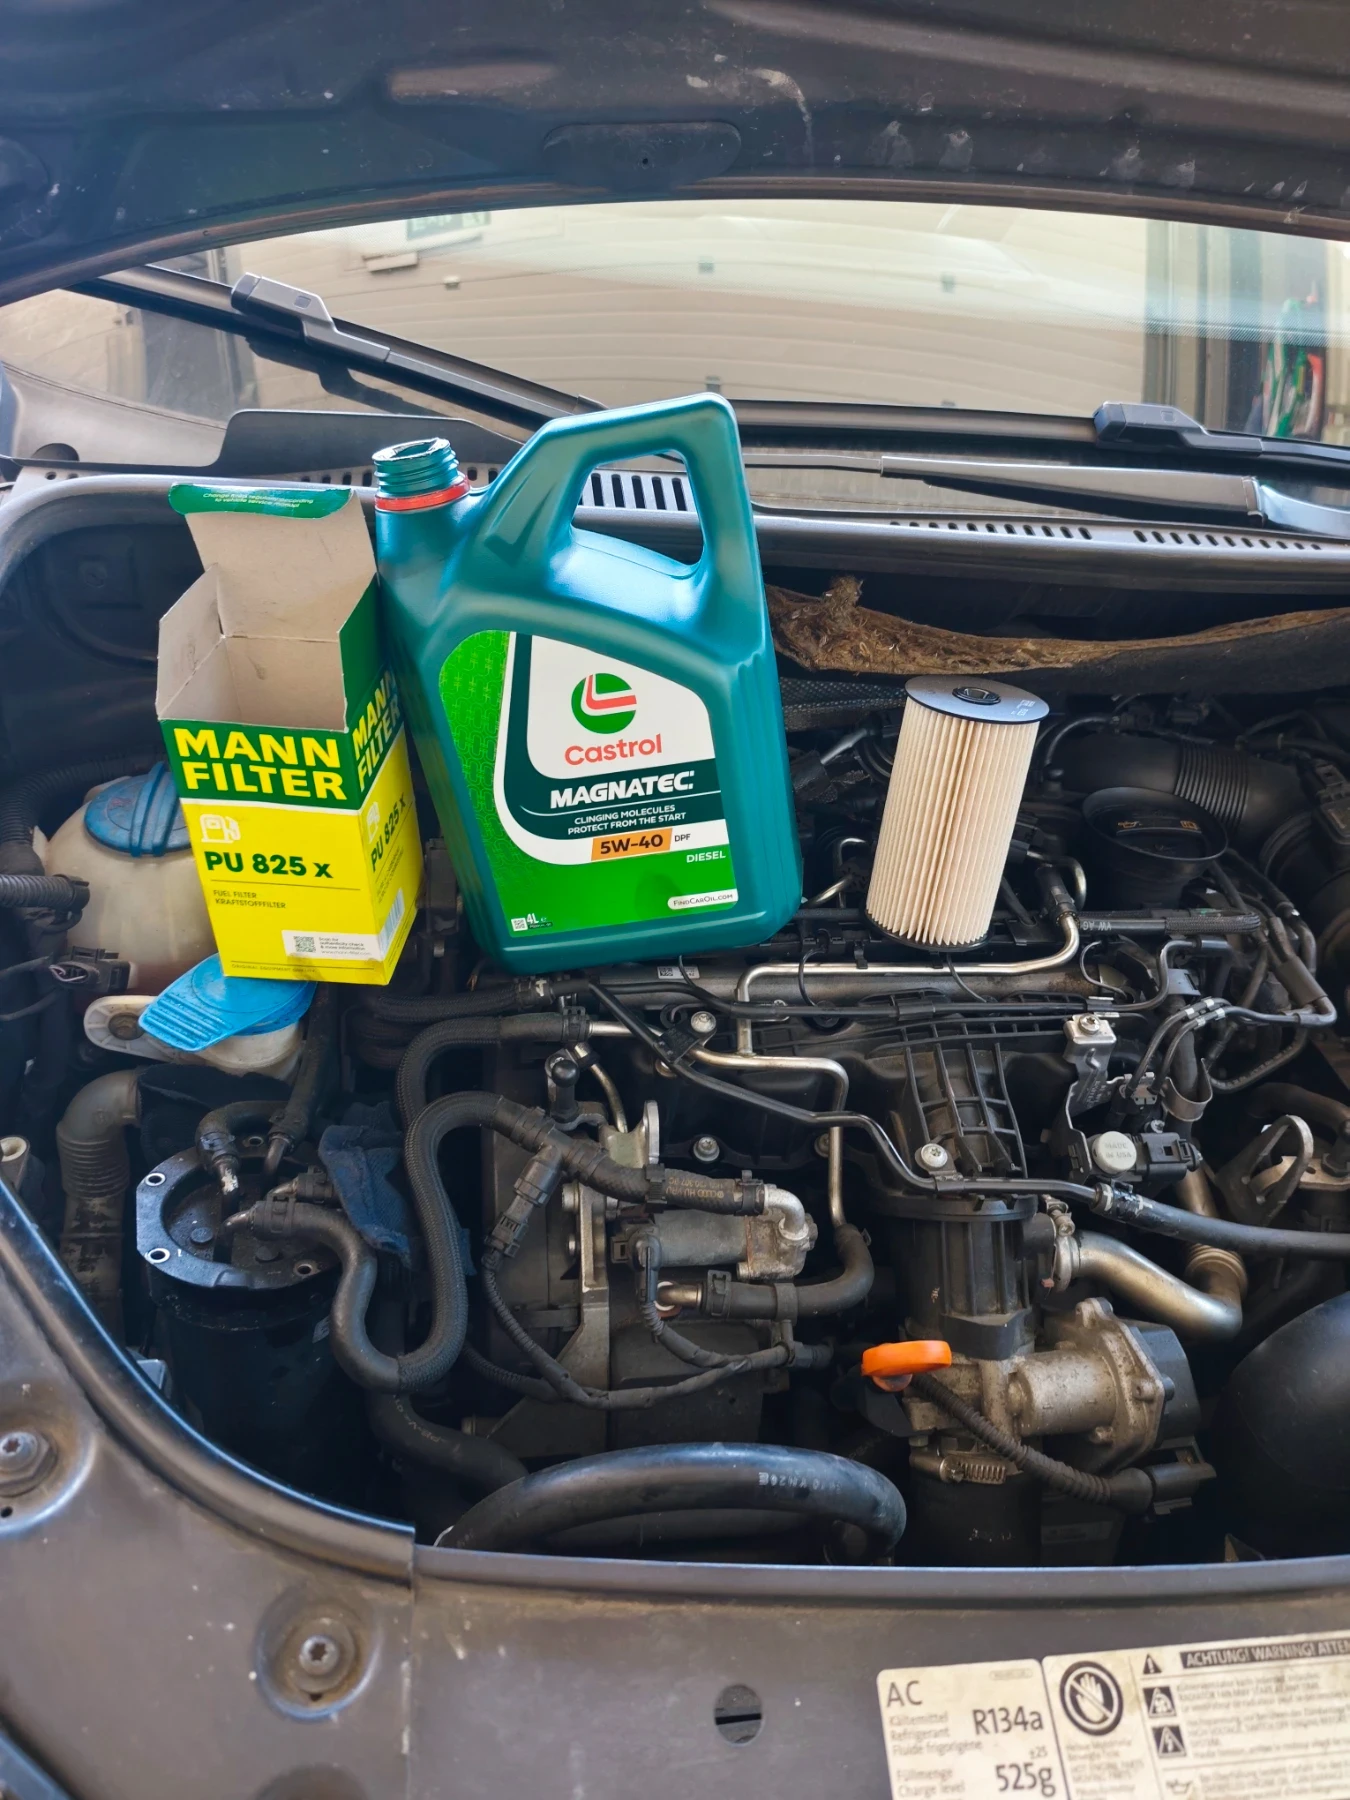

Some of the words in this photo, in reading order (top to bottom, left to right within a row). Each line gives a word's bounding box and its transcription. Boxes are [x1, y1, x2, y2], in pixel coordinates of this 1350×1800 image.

[173, 727, 341, 769] MANN
[357, 695, 401, 793] FILTER
[564, 733, 663, 766] Castrol
[181, 761, 348, 801] FILTER
[550, 770, 695, 810] MAGNATEC
[567, 822, 609, 836] PROTECT
[610, 818, 637, 829] FROM
[638, 815, 657, 825] THE
[658, 812, 687, 823] START
[574, 812, 619, 825] CLINGING
[620, 804, 676, 818] MOLECULES
[371, 836, 384, 873] PU
[384, 802, 400, 845] 825
[600, 833, 664, 855] 5W-40
[674, 833, 691, 843] DPF
[204, 850, 244, 873] PU
[252, 853, 307, 876] 825
[313, 862, 333, 879] x
[686, 850, 726, 864] DIESEL
[213, 889, 232, 898] FUEL
[233, 891, 257, 899] FILTER
[526, 912, 539, 925] 4L
[1186, 1647, 1250, 1667] ACHTUNG!
[1250, 1641, 1317, 1661] WARNING!
[886, 1680, 923, 1708] AC
[972, 1705, 1045, 1736] R134a
[995, 1762, 1057, 1798] 525g
